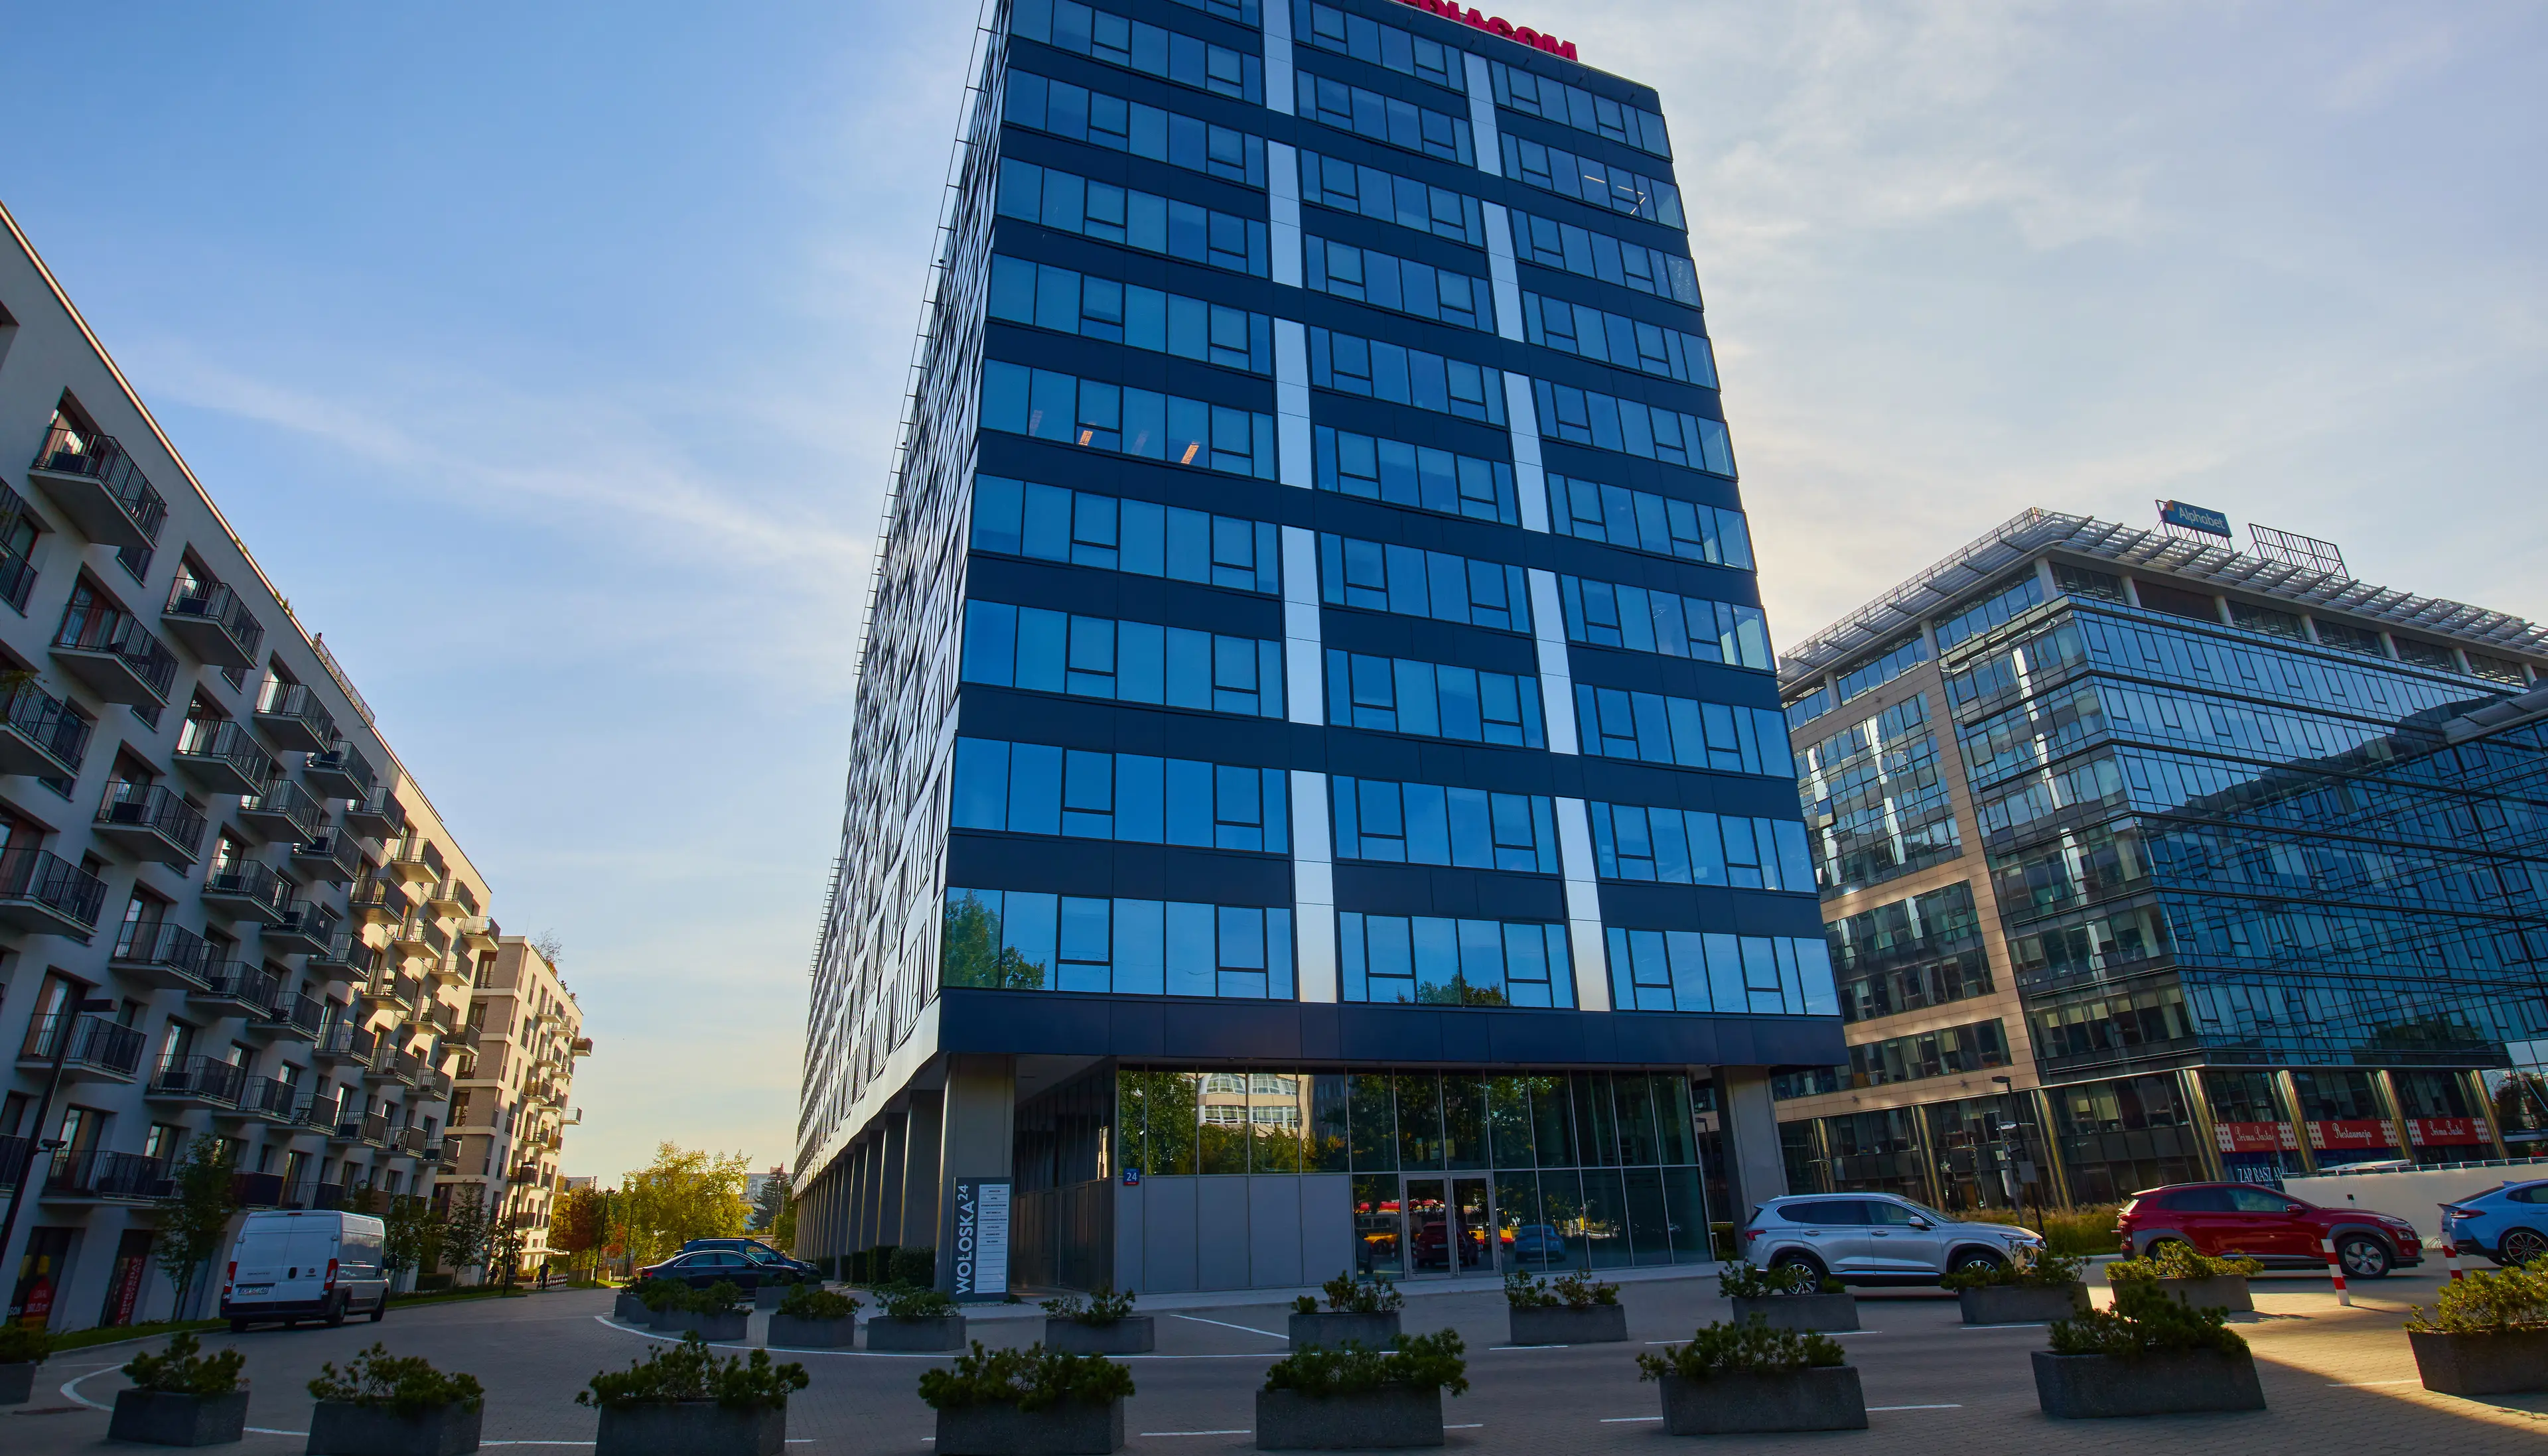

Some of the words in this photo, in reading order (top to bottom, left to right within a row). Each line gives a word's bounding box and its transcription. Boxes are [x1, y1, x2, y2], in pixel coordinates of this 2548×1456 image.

[1395, 0, 1579, 62] DIACOM
[2179, 507, 2226, 529] Alphabet
[2234, 1126, 2255, 1142] Prima
[2332, 1122, 2372, 1146] Restauracja
[2429, 1120, 2448, 1136] Prima
[1126, 1172, 1137, 1181] 24
[2237, 1166, 2288, 1183] ZAPRASZA
[957, 1184, 969, 1201] 24
[956, 1200, 975, 1295] WOŁOSKA
